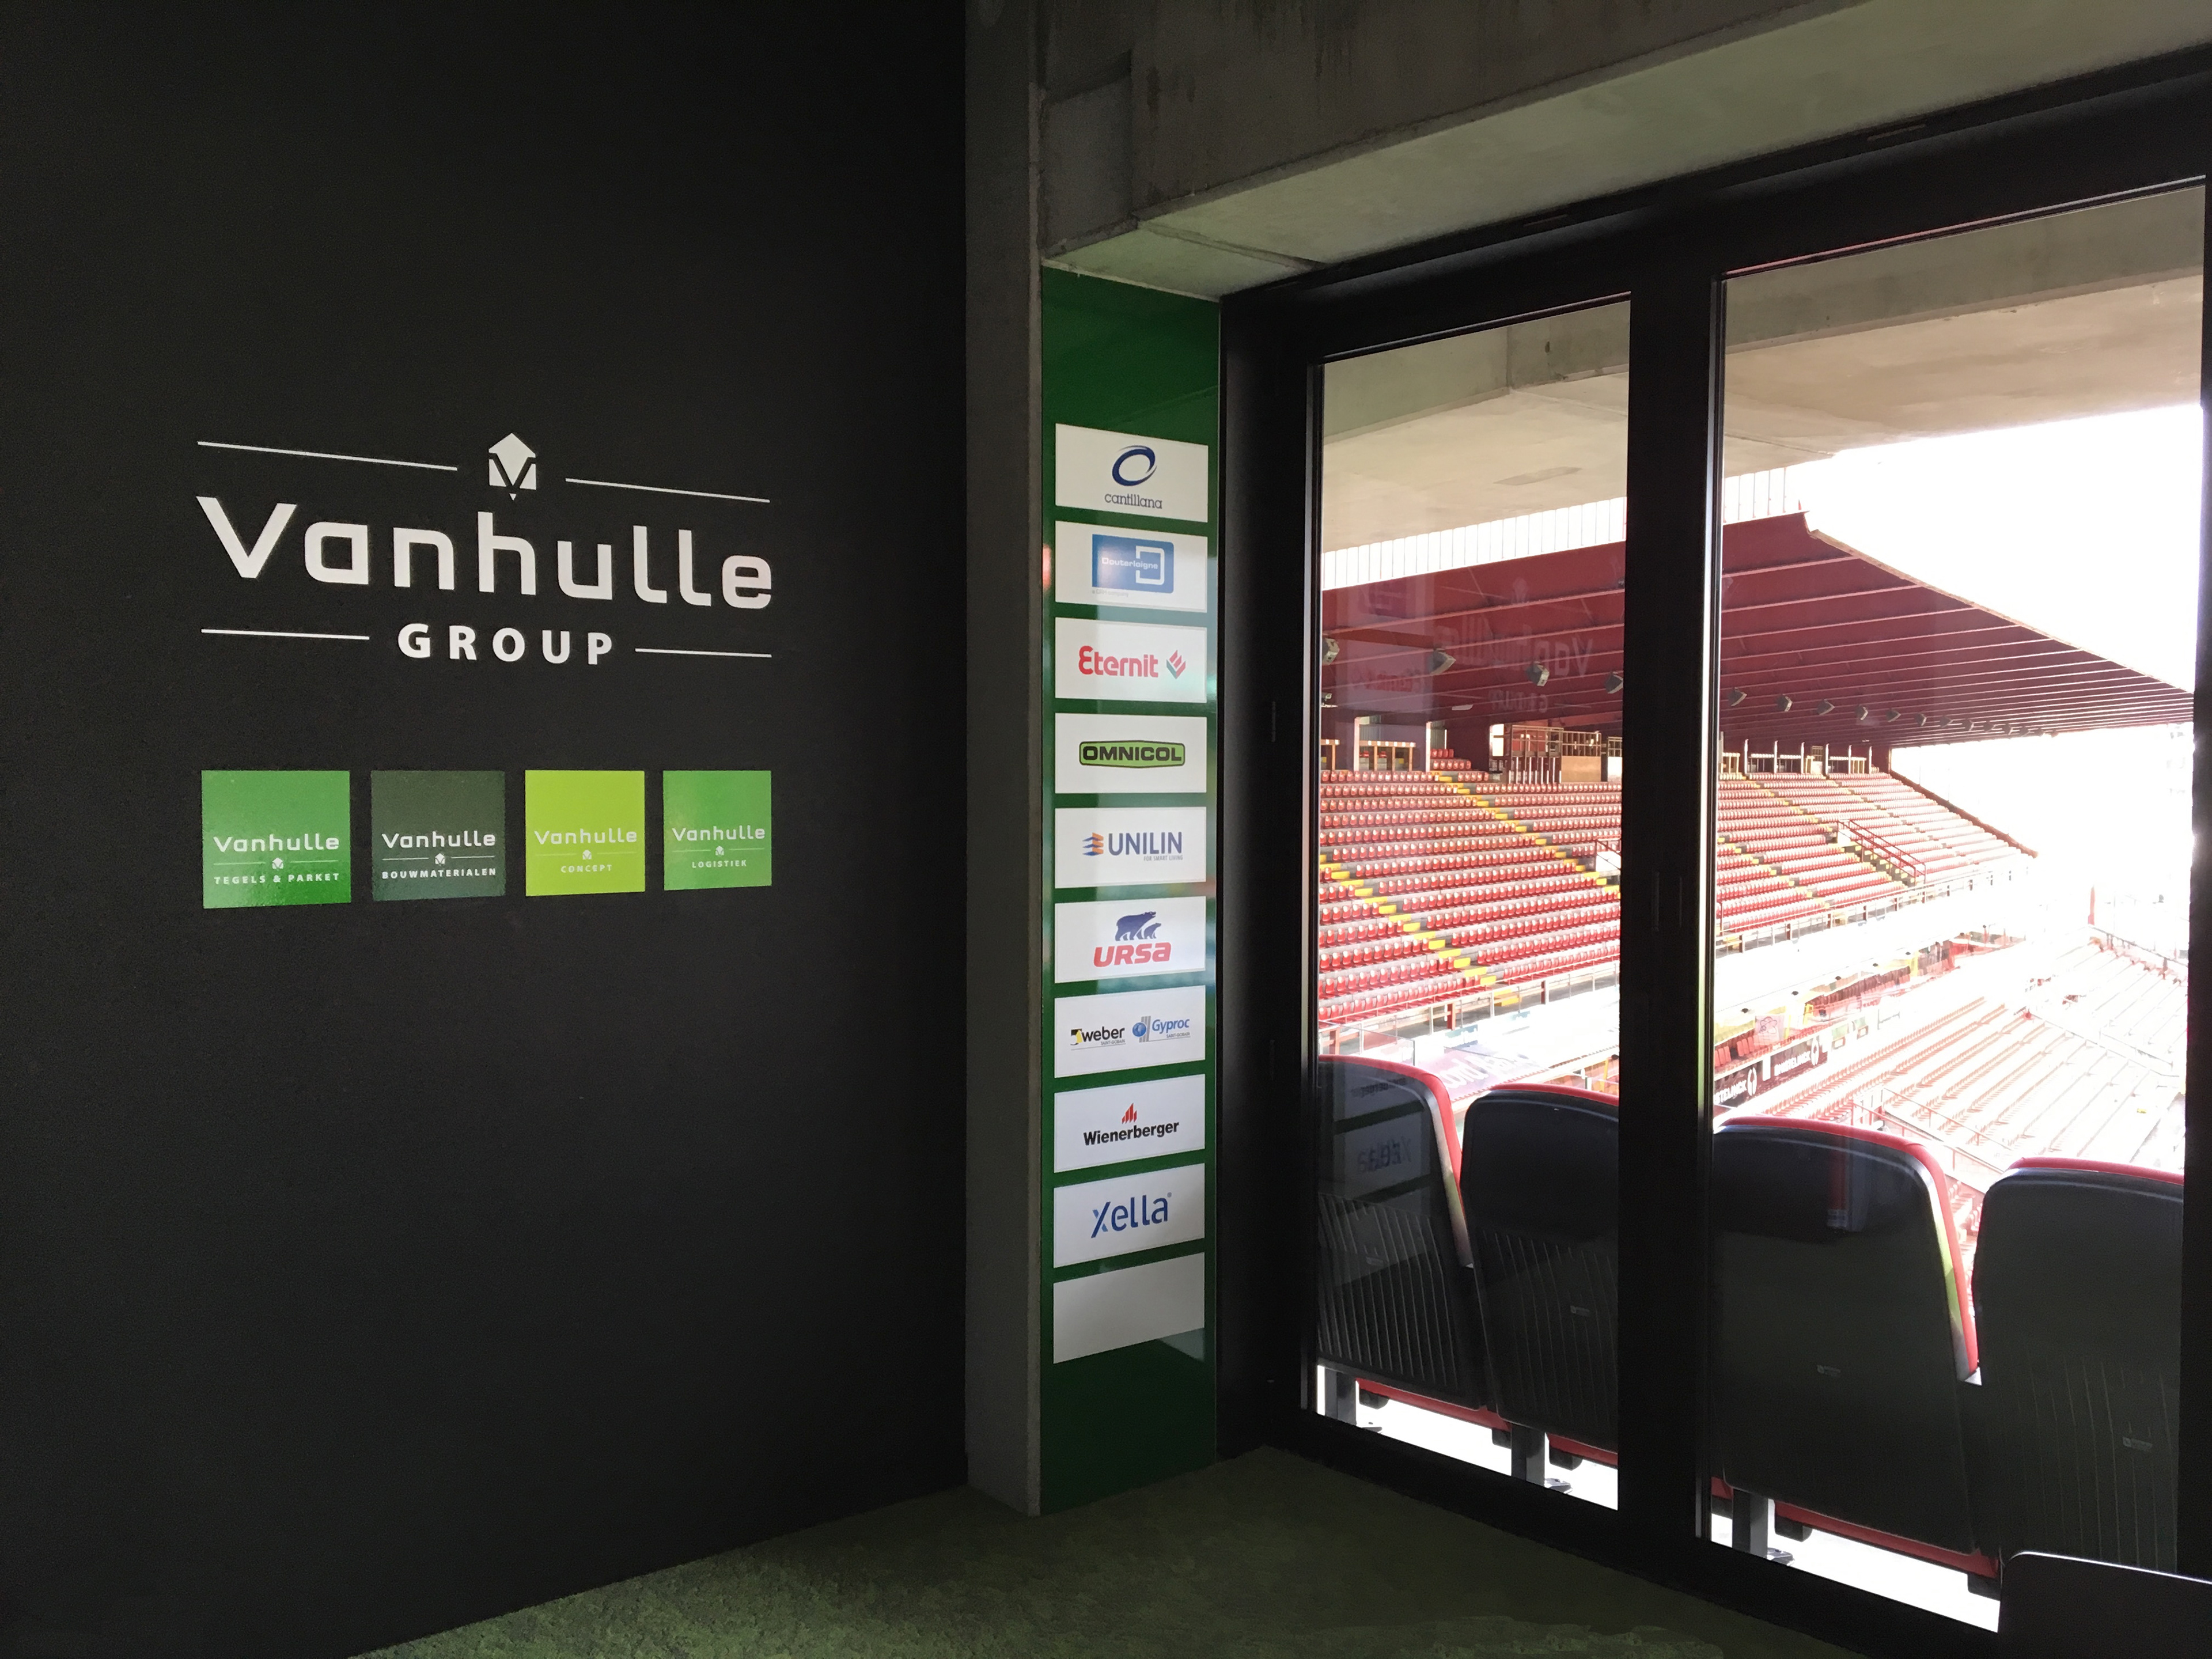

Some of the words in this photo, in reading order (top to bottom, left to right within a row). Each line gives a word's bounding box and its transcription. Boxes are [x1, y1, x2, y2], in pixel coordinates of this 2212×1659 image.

[1104, 493, 1162, 509] cantillana
[195, 495, 772, 609] Vanhulle
[1101, 557, 1158, 570] Douterloigne
[397, 623, 612, 665] GROUP
[1078, 645, 1158, 678] Eternit
[1083, 746, 1181, 761] OMNICOL
[382, 830, 496, 848] Vanhulle
[534, 827, 637, 844] Vanhulle
[672, 825, 765, 841] Vanhulle
[213, 833, 340, 852] Vanhulle
[1108, 831, 1182, 856] UNILIN
[560, 864, 612, 873] CONCEPT
[692, 859, 747, 869] LOGISTIEK
[214, 875, 266, 885] TEGELS
[273, 873, 281, 883] &
[288, 873, 340, 882] PARKET
[382, 868, 496, 879] BOUWMATERIALEN
[1152, 1018, 1190, 1034] Gyproc
[1082, 1027, 1125, 1042] weber
[1084, 1122, 1179, 1146] Wienerberger
